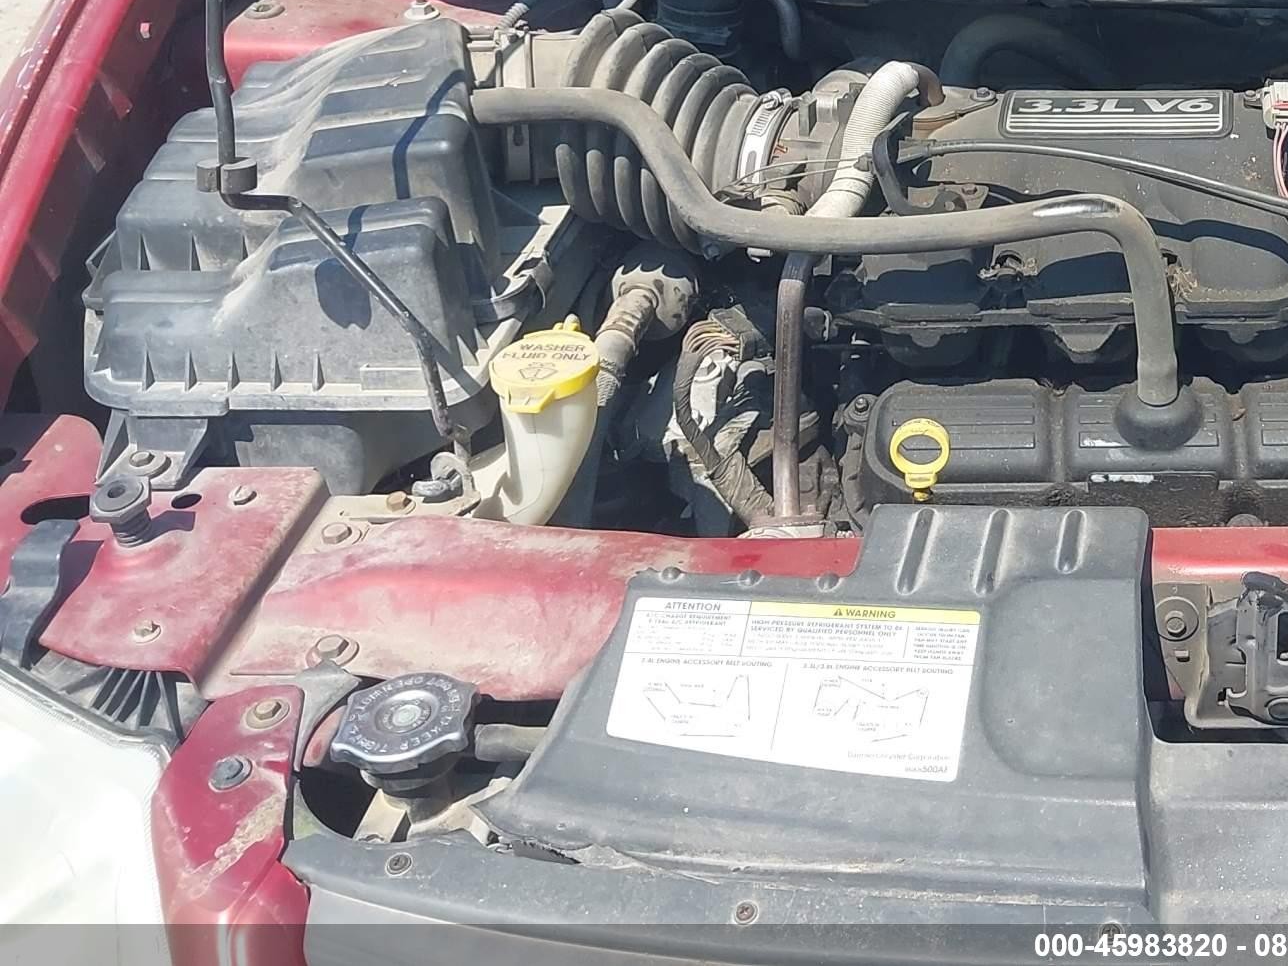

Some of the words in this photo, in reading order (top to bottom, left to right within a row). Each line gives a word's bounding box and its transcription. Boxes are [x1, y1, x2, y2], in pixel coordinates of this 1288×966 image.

[1018, 98, 1135, 113] 3.3L
[1144, 97, 1214, 113] V6
[520, 343, 586, 352] WASHER
[502, 352, 546, 360] FLUID
[552, 352, 591, 362] ONLY
[664, 601, 721, 611] ATTENTION
[845, 608, 896, 619] WARNING
[751, 625, 784, 633] SERVICED
[862, 665, 905, 673] ACCESSORY
